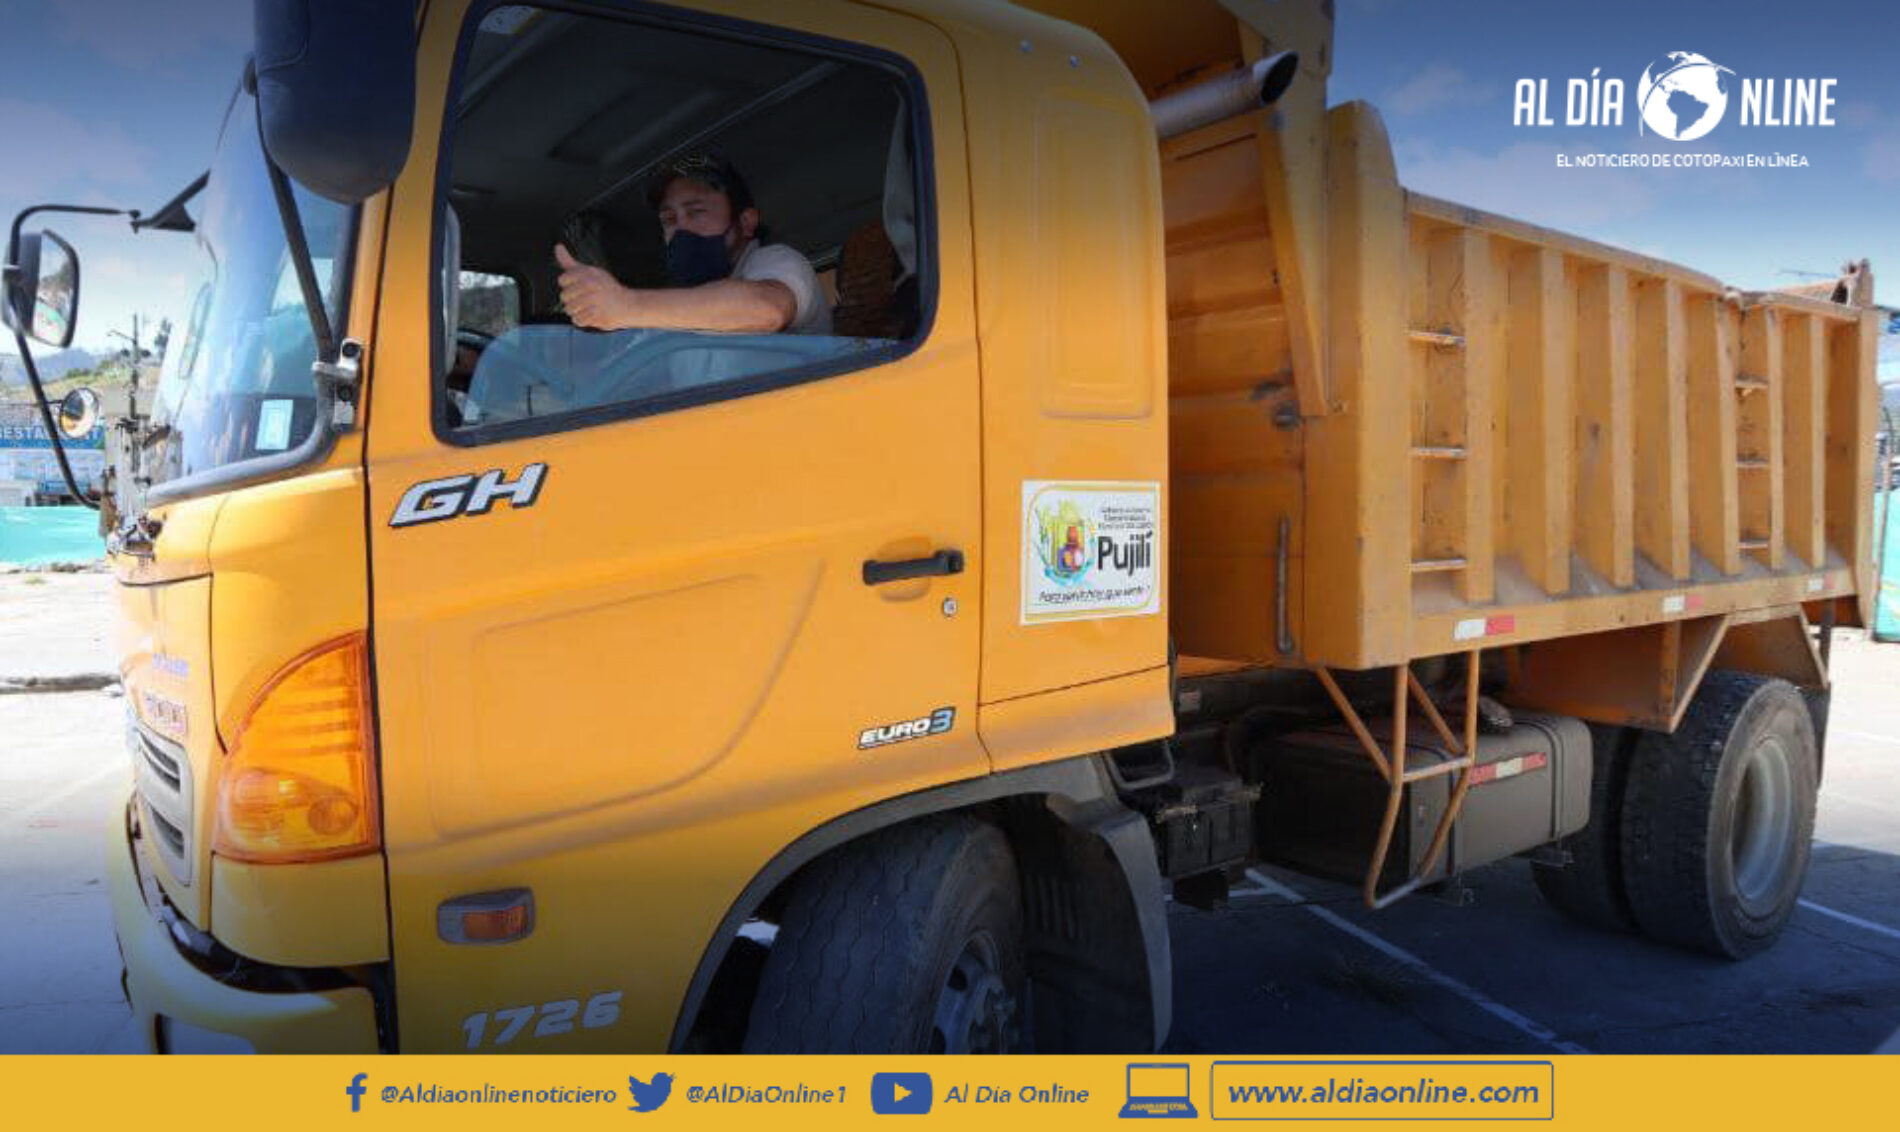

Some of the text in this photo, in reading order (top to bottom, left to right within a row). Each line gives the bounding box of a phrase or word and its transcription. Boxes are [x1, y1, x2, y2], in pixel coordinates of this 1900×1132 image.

[389, 462, 549, 528] GH
[1097, 530, 1153, 577] Pujilí
[463, 990, 623, 1049] 1726
